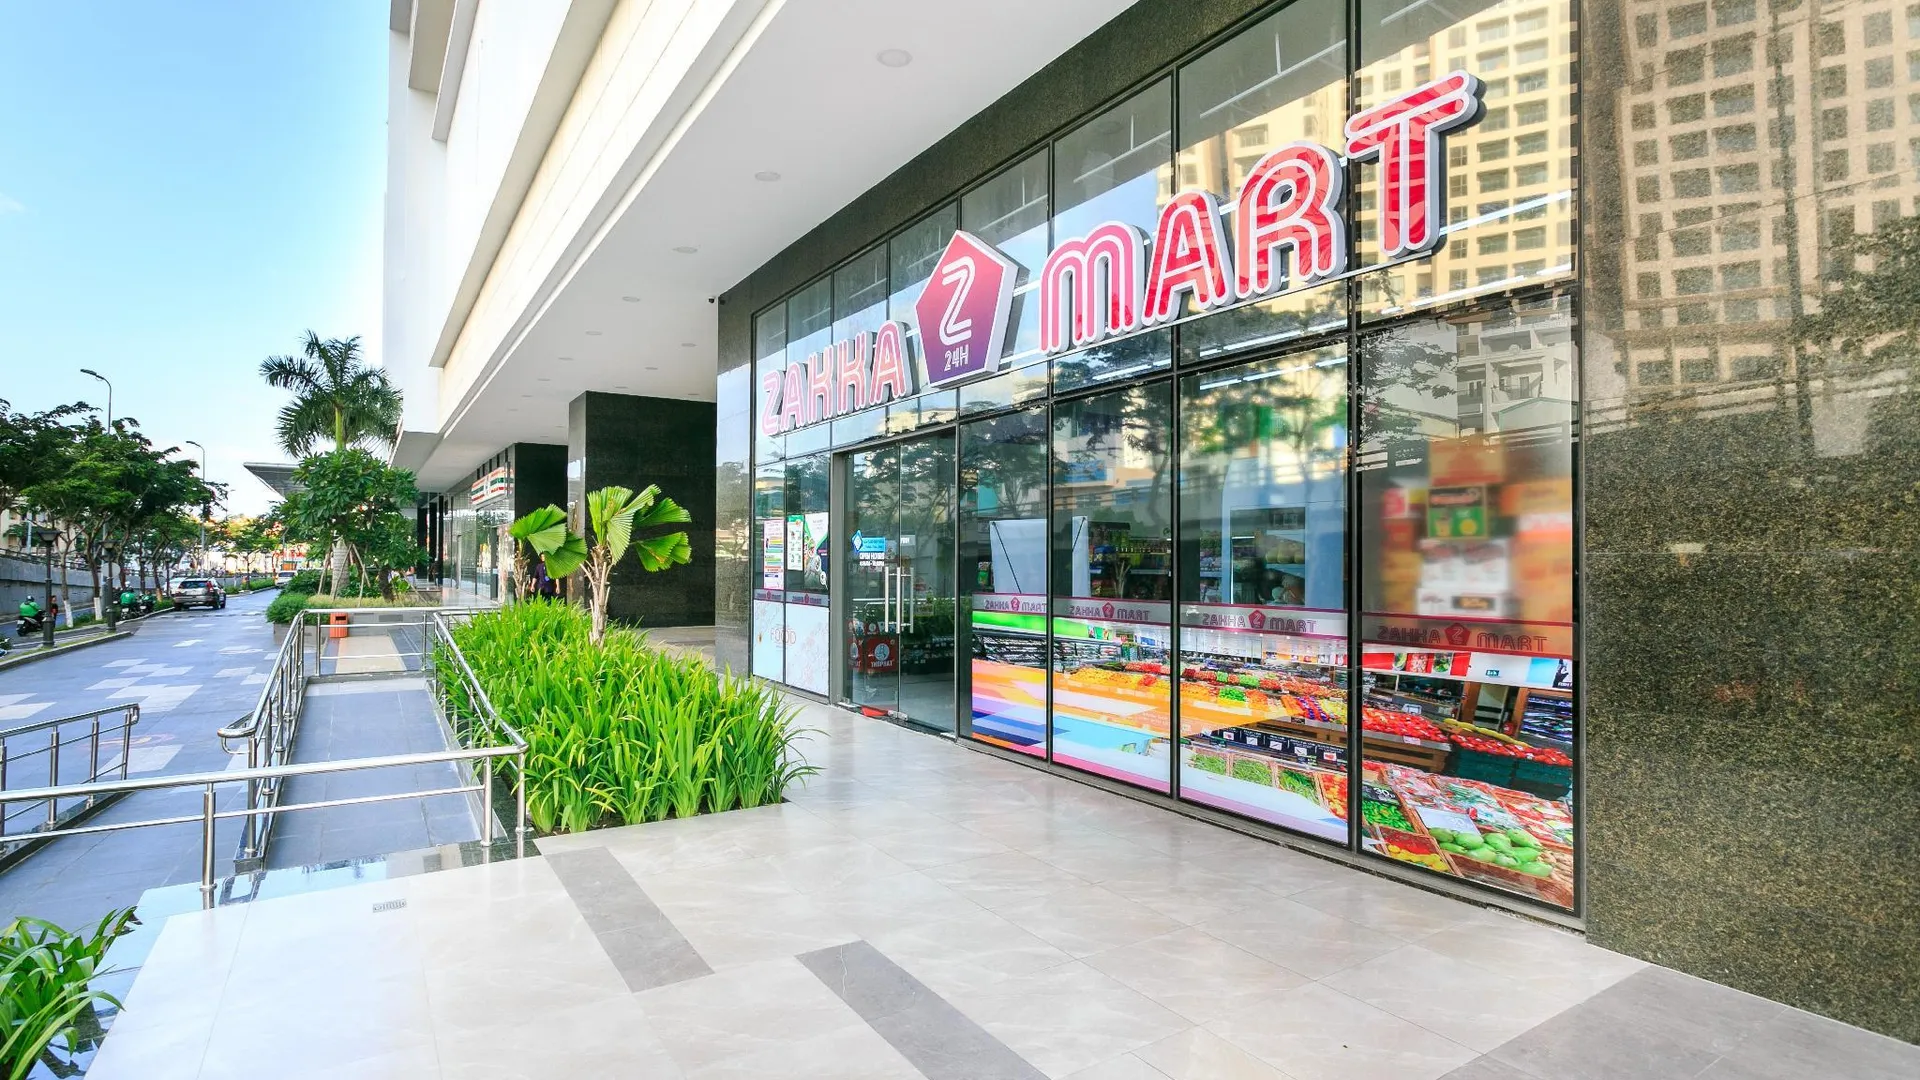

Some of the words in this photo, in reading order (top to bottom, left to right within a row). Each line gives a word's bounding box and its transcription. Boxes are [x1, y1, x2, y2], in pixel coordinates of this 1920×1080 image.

[762, 320, 912, 436] ZAKKA
[1039, 70, 1478, 354] MART
[943, 344, 970, 372] 24H
[1117, 608, 1151, 620] MART
[1270, 617, 1317, 633] MART
[1476, 632, 1548, 652] MART
